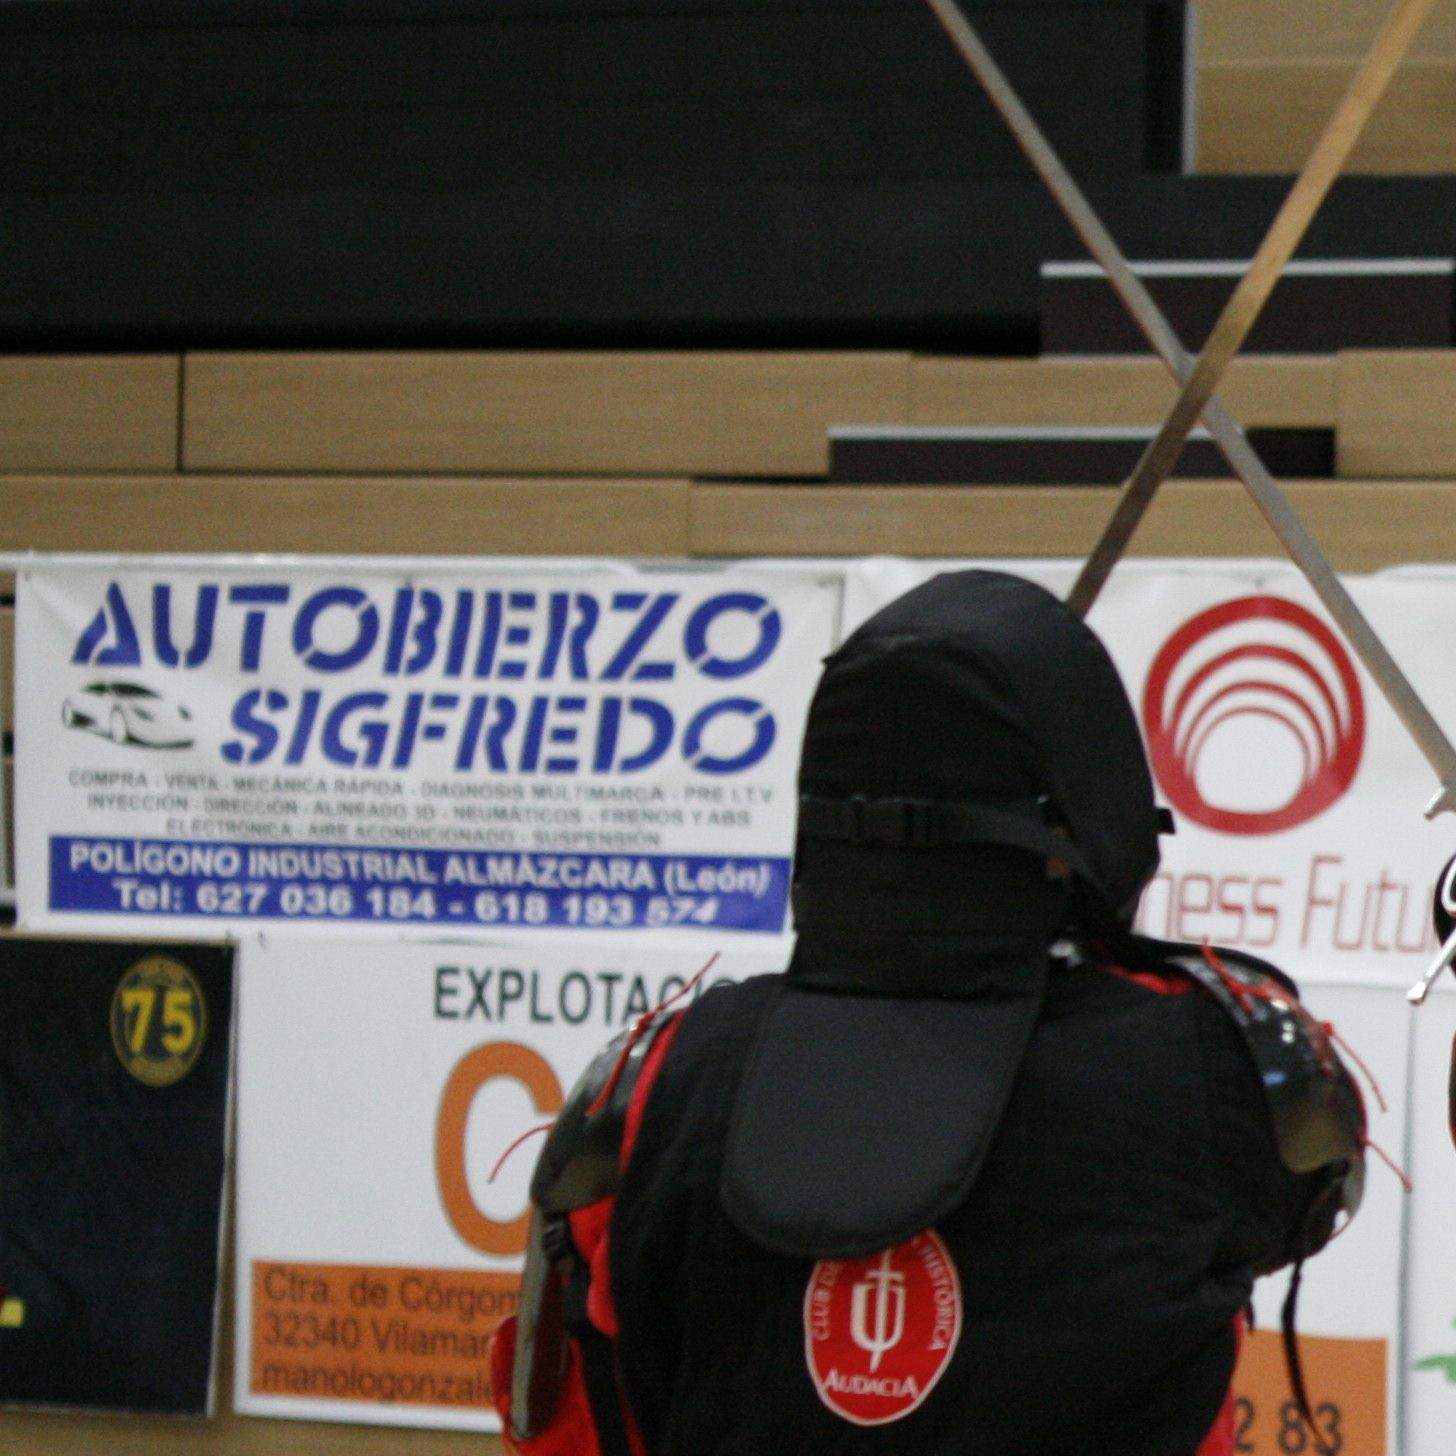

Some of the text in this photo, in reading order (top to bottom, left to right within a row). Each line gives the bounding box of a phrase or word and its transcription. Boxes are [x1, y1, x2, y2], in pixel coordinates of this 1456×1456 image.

[71, 581, 783, 683] AUTOBIERZO
[220, 688, 778, 776] SIGFREDO
[68, 769, 148, 788] COMPRA
[165, 771, 219, 792] VENTA
[422, 779, 525, 800] DIAGNOSIS
[531, 783, 664, 801] MULTIMARCA
[684, 783, 723, 802] PRE
[313, 800, 408, 819] ALINEADO
[601, 807, 684, 826] FRENOS
[707, 808, 750, 827] ABS
[70, 840, 771, 897] POLÍGONO INDUSTRIAL ALMÁZCARA (León)
[112, 876, 184, 910] Tel:
[196, 881, 268, 914] 627
[279, 883, 353, 916] 036
[366, 887, 436, 919] 184
[475, 890, 549, 923] 618
[563, 893, 635, 926] 193
[1301, 855, 1434, 953] Futu
[433, 965, 743, 1025] EXPLOTAC
[121, 989, 196, 1055] 75
[352, 1274, 389, 1310] de
[264, 1309, 360, 1351] 32340
[824, 1367, 921, 1398] AUDACIA
